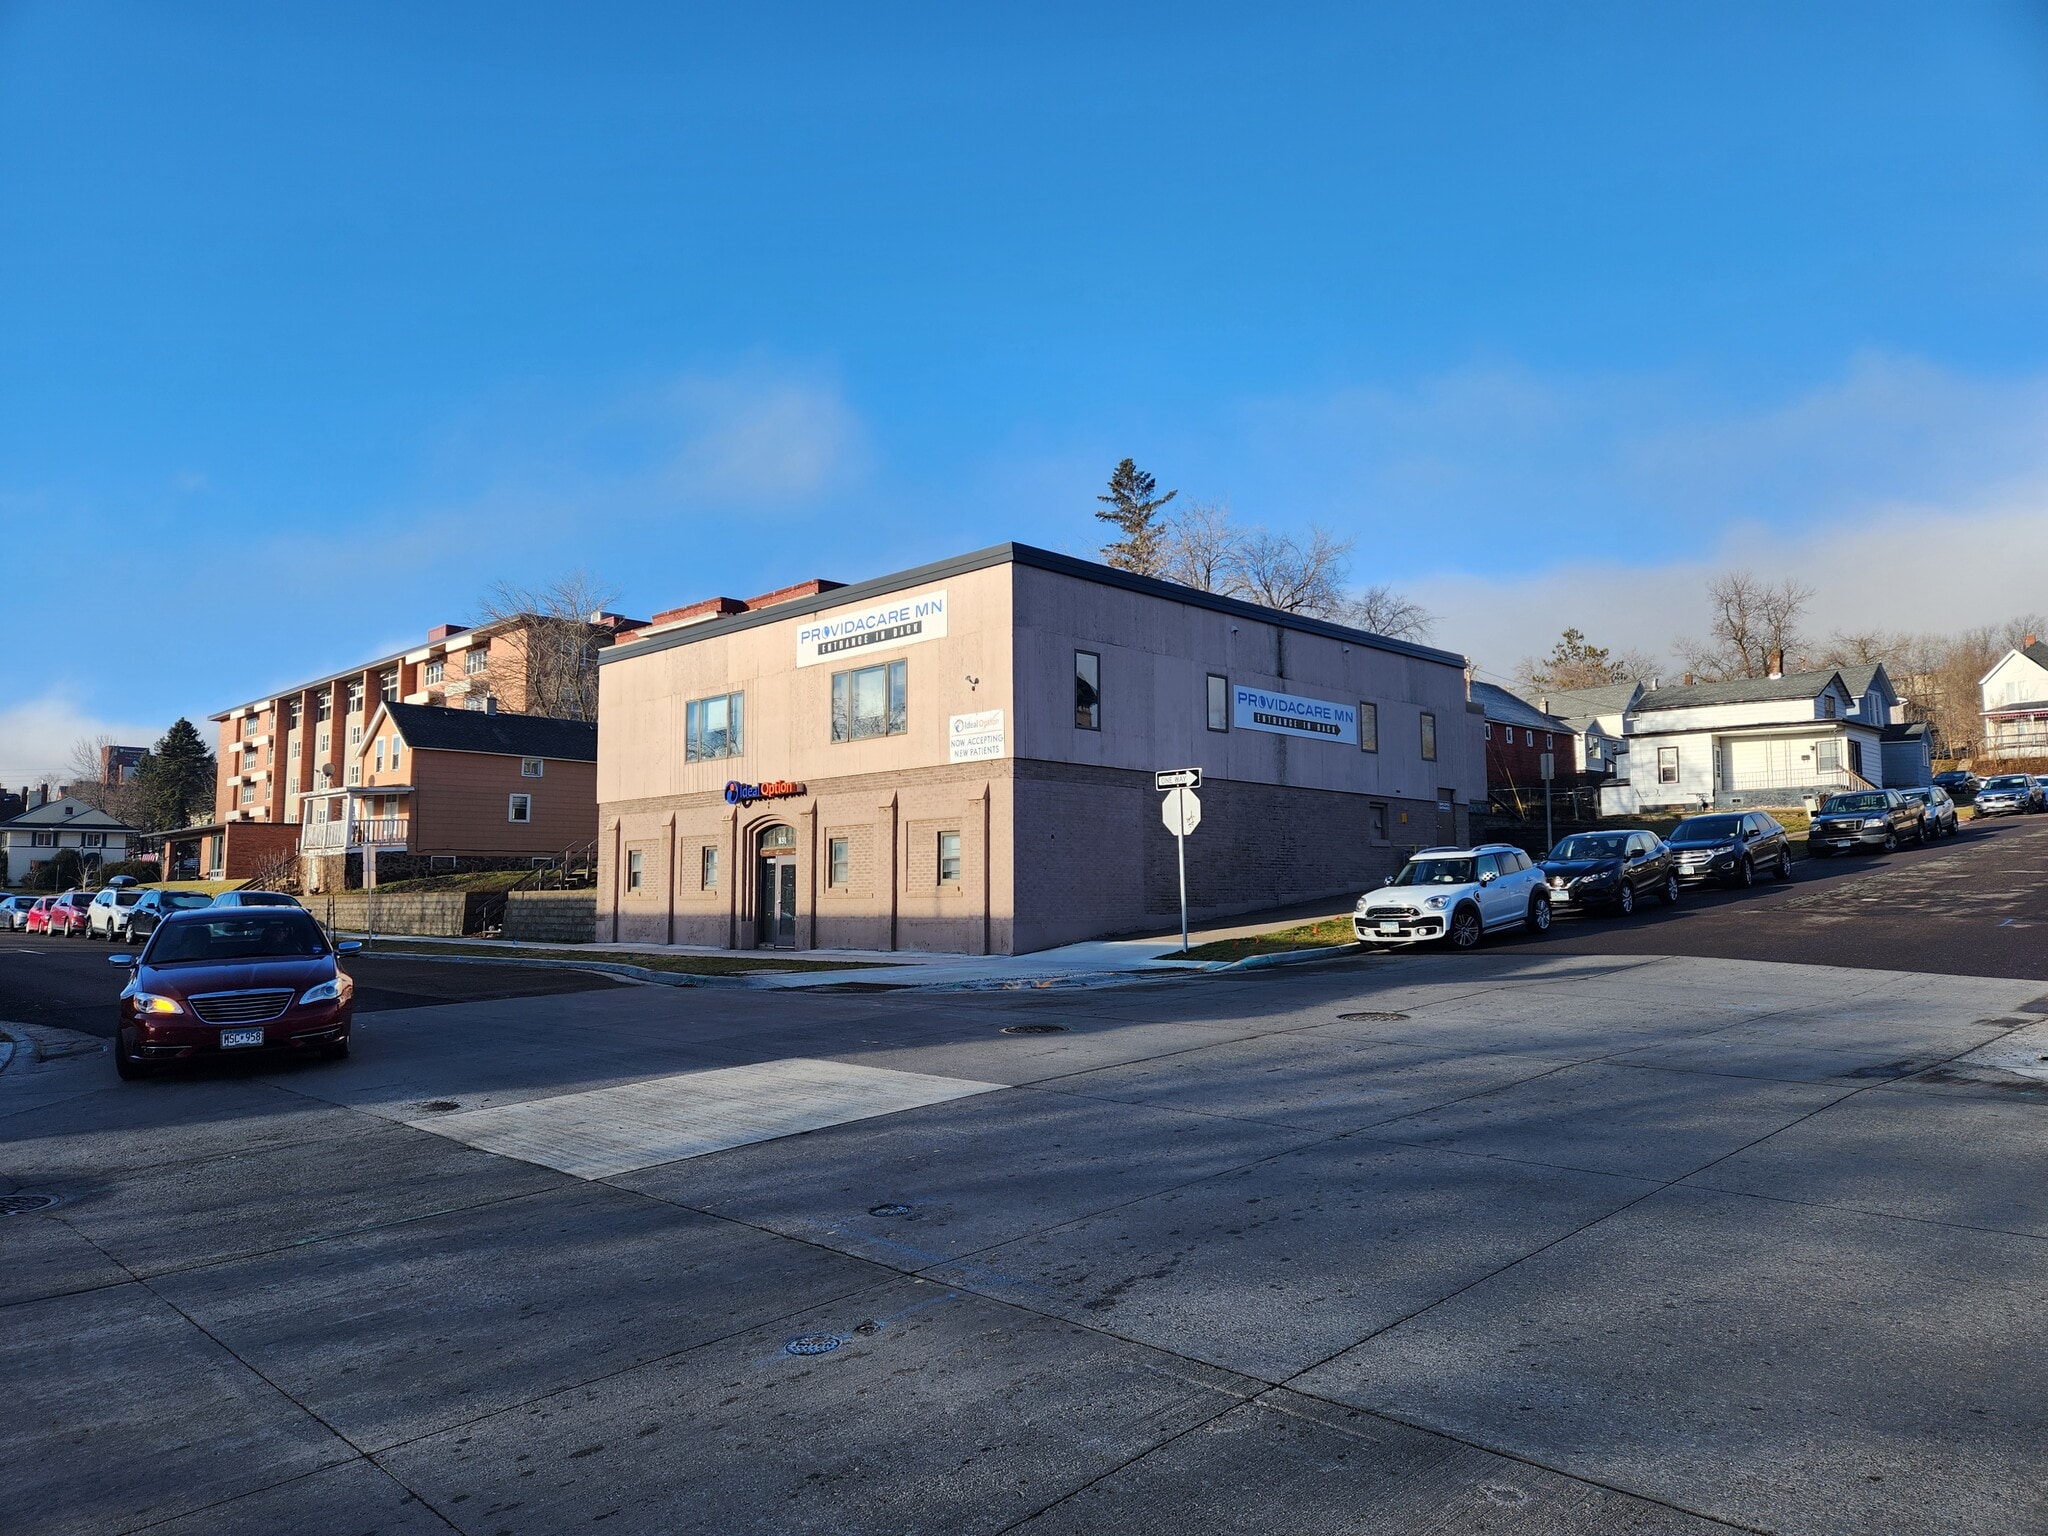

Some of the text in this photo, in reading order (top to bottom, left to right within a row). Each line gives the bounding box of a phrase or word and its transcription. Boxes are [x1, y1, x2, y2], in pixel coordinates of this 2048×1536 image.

[801, 599, 943, 644] PROVIDACARE MN
[821, 622, 919, 654] ENTRANCE IN BACK
[1238, 691, 1354, 723] PROVIDACARE MN
[965, 718, 999, 729] Ideal Option
[1257, 713, 1337, 734] ENTRANCE IN BACK
[951, 734, 1003, 747] NOW ACCEPTING
[954, 745, 999, 757] NEW PATIENTS
[1160, 775, 1187, 785] ONE WAY
[760, 782, 793, 797] Option
